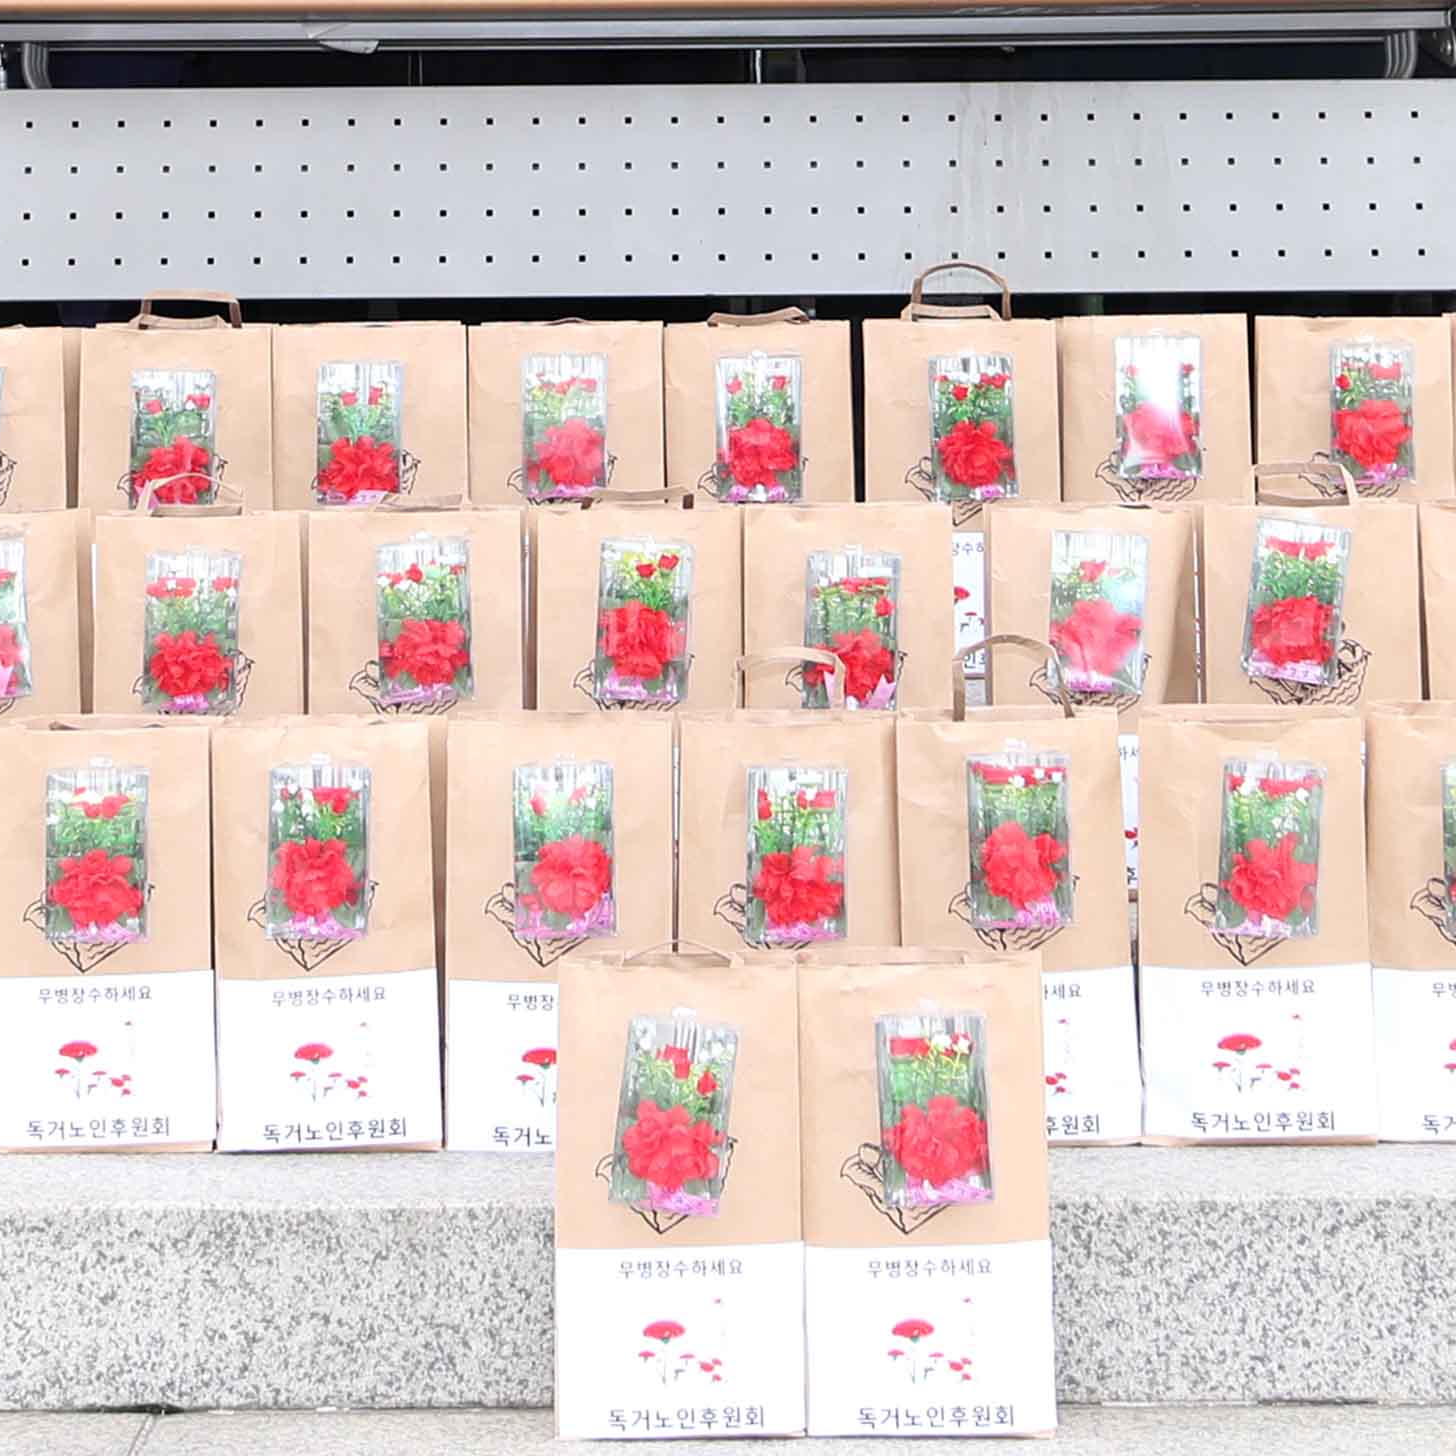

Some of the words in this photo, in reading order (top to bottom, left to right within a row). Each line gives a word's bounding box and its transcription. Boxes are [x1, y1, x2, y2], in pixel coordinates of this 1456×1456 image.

[38, 985, 153, 1005] 무병장수하세요
[271, 986, 386, 1008] 무병장수하세요
[1200, 979, 1316, 999] 무병장수하세요
[27, 1117, 170, 1138] 독거노인후원회
[263, 1117, 407, 1143] 독거노인후원회
[1191, 1111, 1337, 1134] 독거노인후원회
[619, 1257, 744, 1280] 무병장수하세요
[868, 1257, 992, 1279] 무병장수하세요
[609, 1405, 766, 1430] 독거노인후원회
[858, 1405, 1015, 1429] 독거노인후원회
